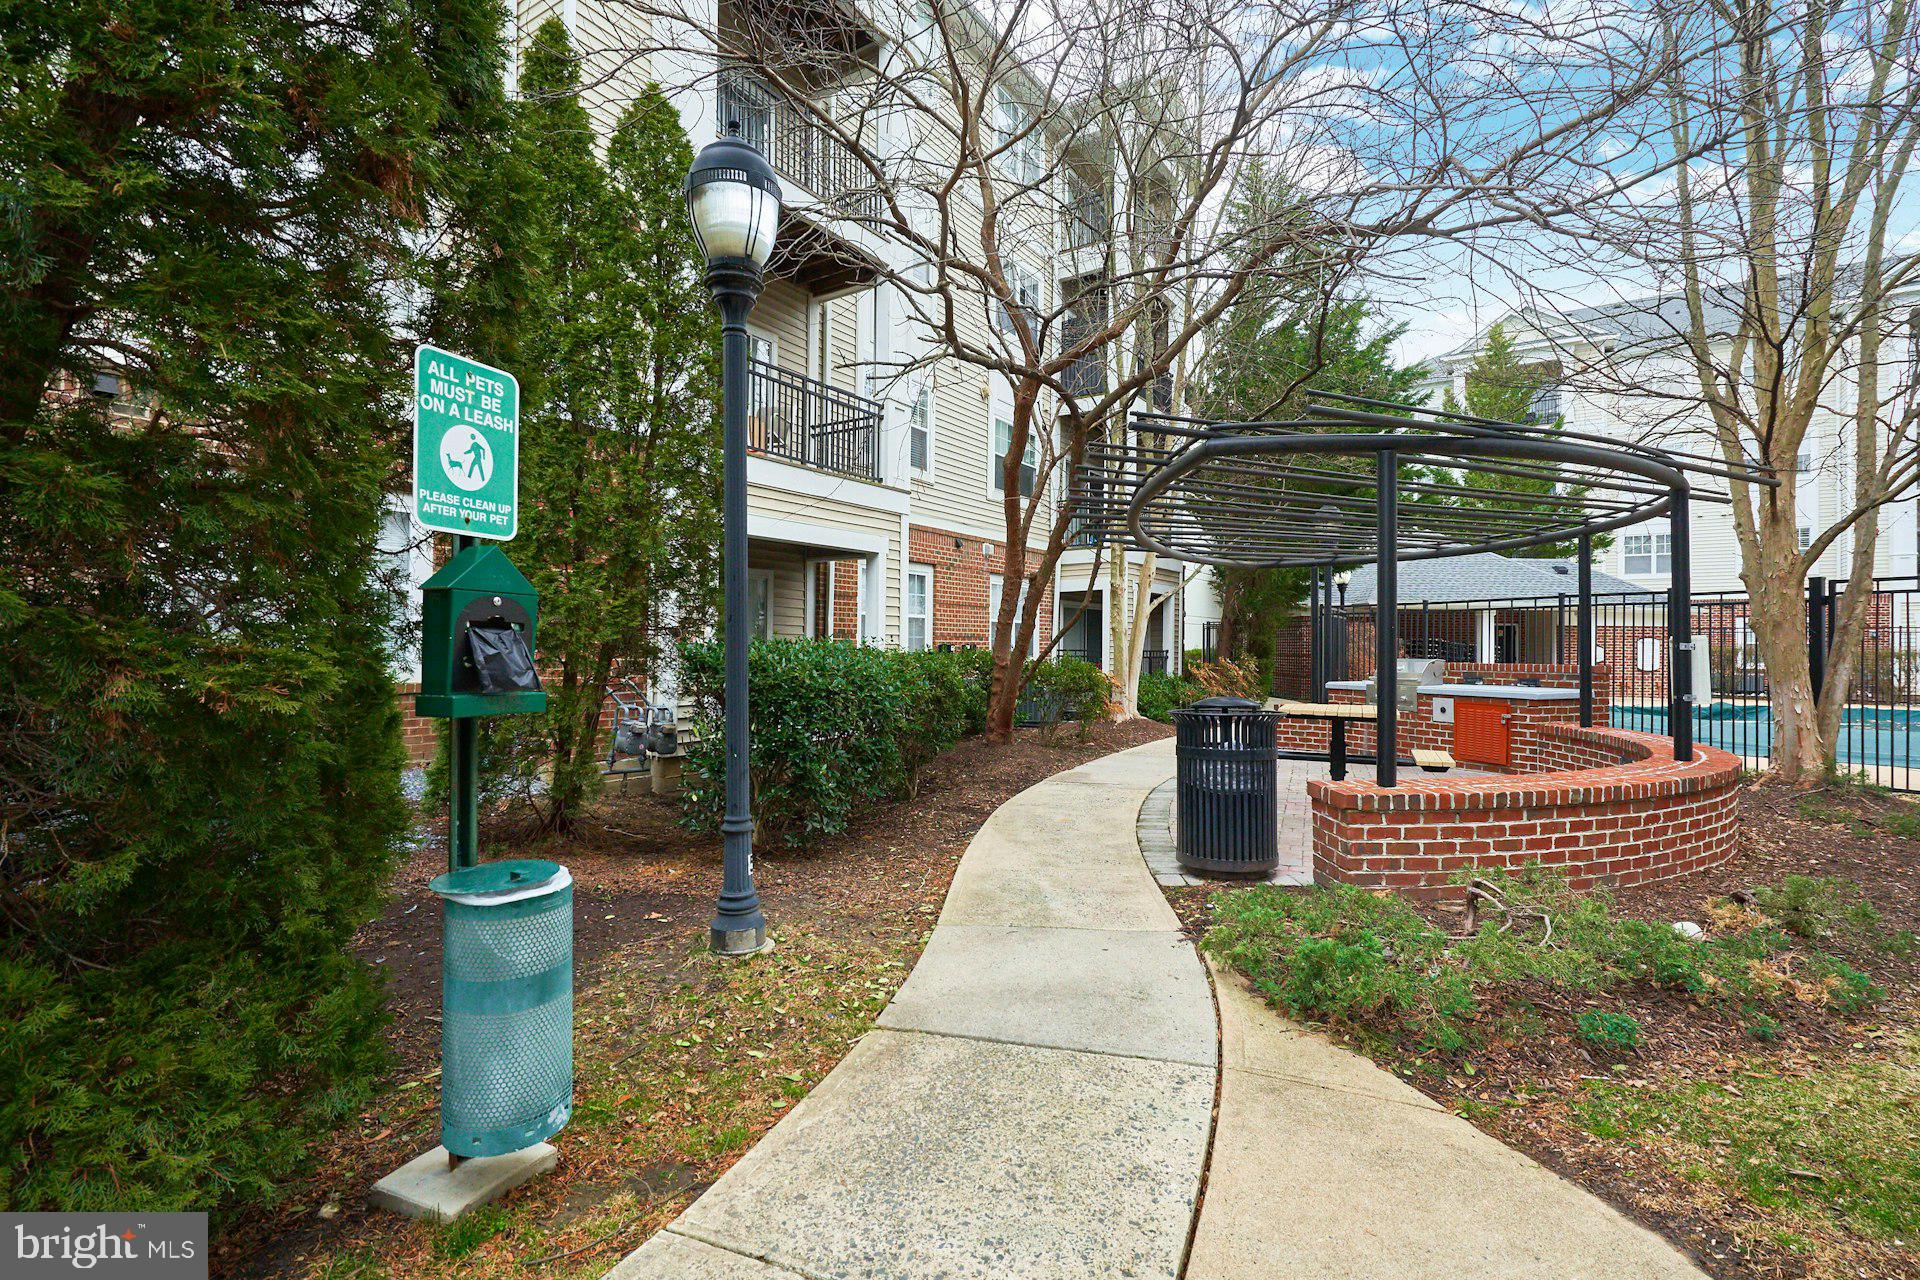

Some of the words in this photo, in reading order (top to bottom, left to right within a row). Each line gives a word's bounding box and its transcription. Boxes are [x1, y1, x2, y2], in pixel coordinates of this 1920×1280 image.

[427, 360, 460, 383] ALL
[465, 371, 504, 397] PETS
[430, 379, 475, 405] MUST
[481, 394, 502, 413] BE
[420, 394, 445, 414] ON
[449, 402, 461, 419] A
[464, 406, 514, 434] LEASH
[419, 488, 460, 506] PLEASE
[462, 497, 496, 512] CLEAN
[498, 504, 512, 514] UP
[422, 502, 457, 517] AFTER
[459, 508, 487, 522] YOUR
[489, 514, 509, 525] PET
